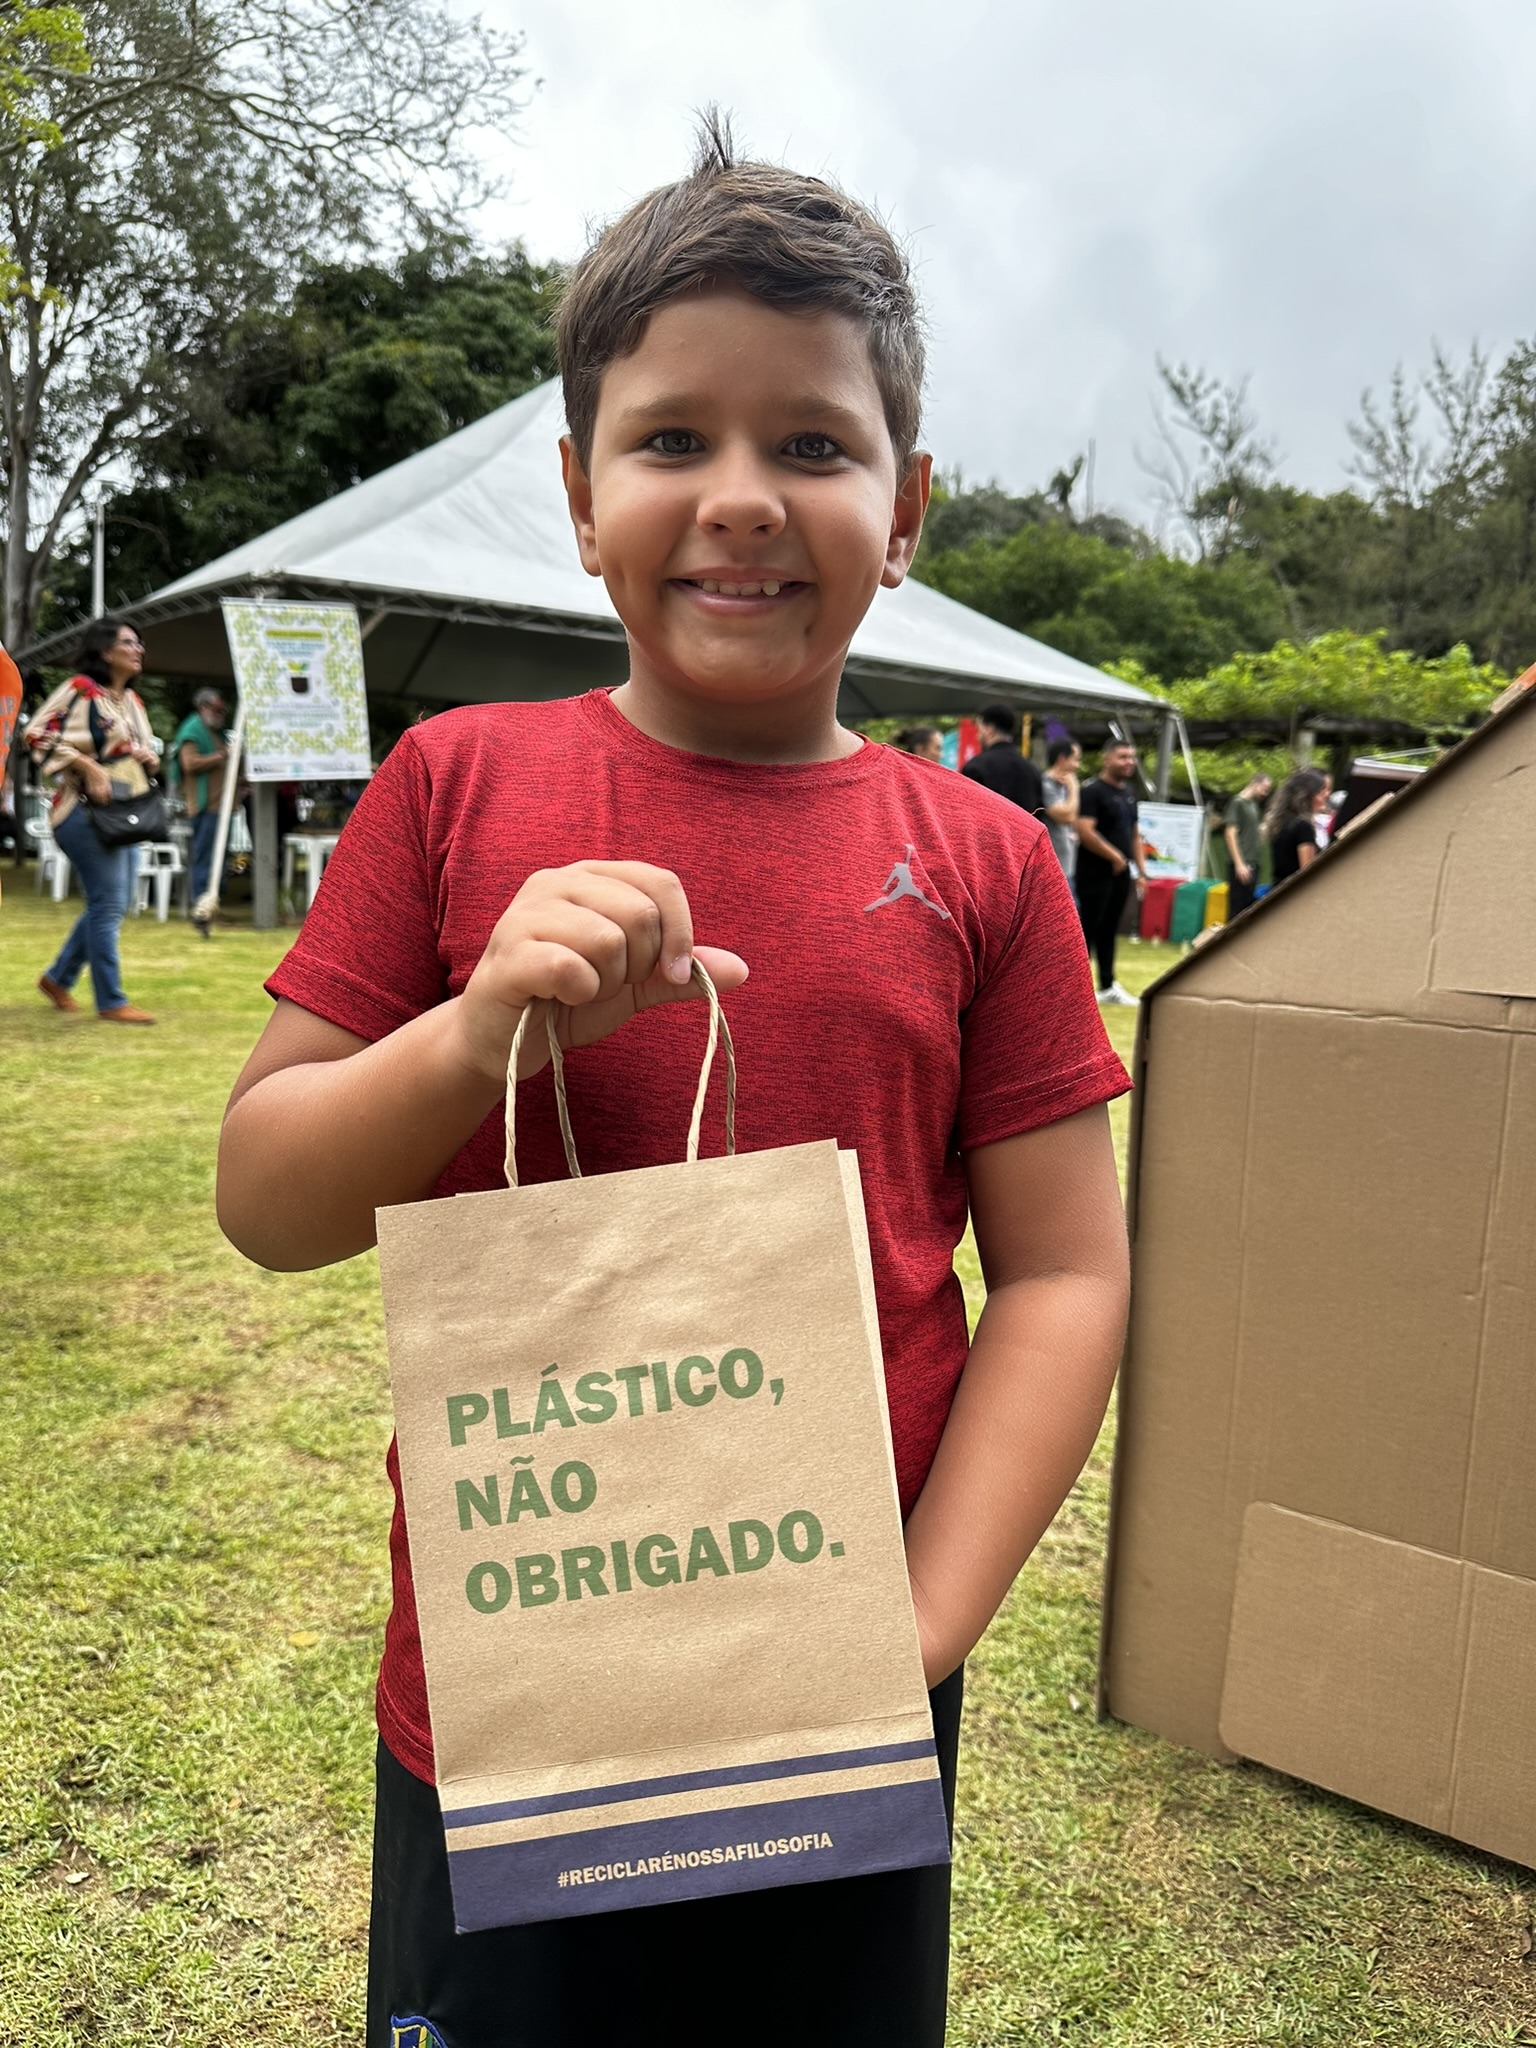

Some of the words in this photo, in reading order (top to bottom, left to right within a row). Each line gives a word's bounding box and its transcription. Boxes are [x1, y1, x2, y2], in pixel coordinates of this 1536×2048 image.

[447, 1348, 785, 1447] PLÁSTICO,
[455, 1455, 597, 1531] NÃO
[466, 1510, 845, 1614] OBRIGADO.
[557, 1832, 832, 1887] #RECICLARÉNOSSAFILOSOFIA
